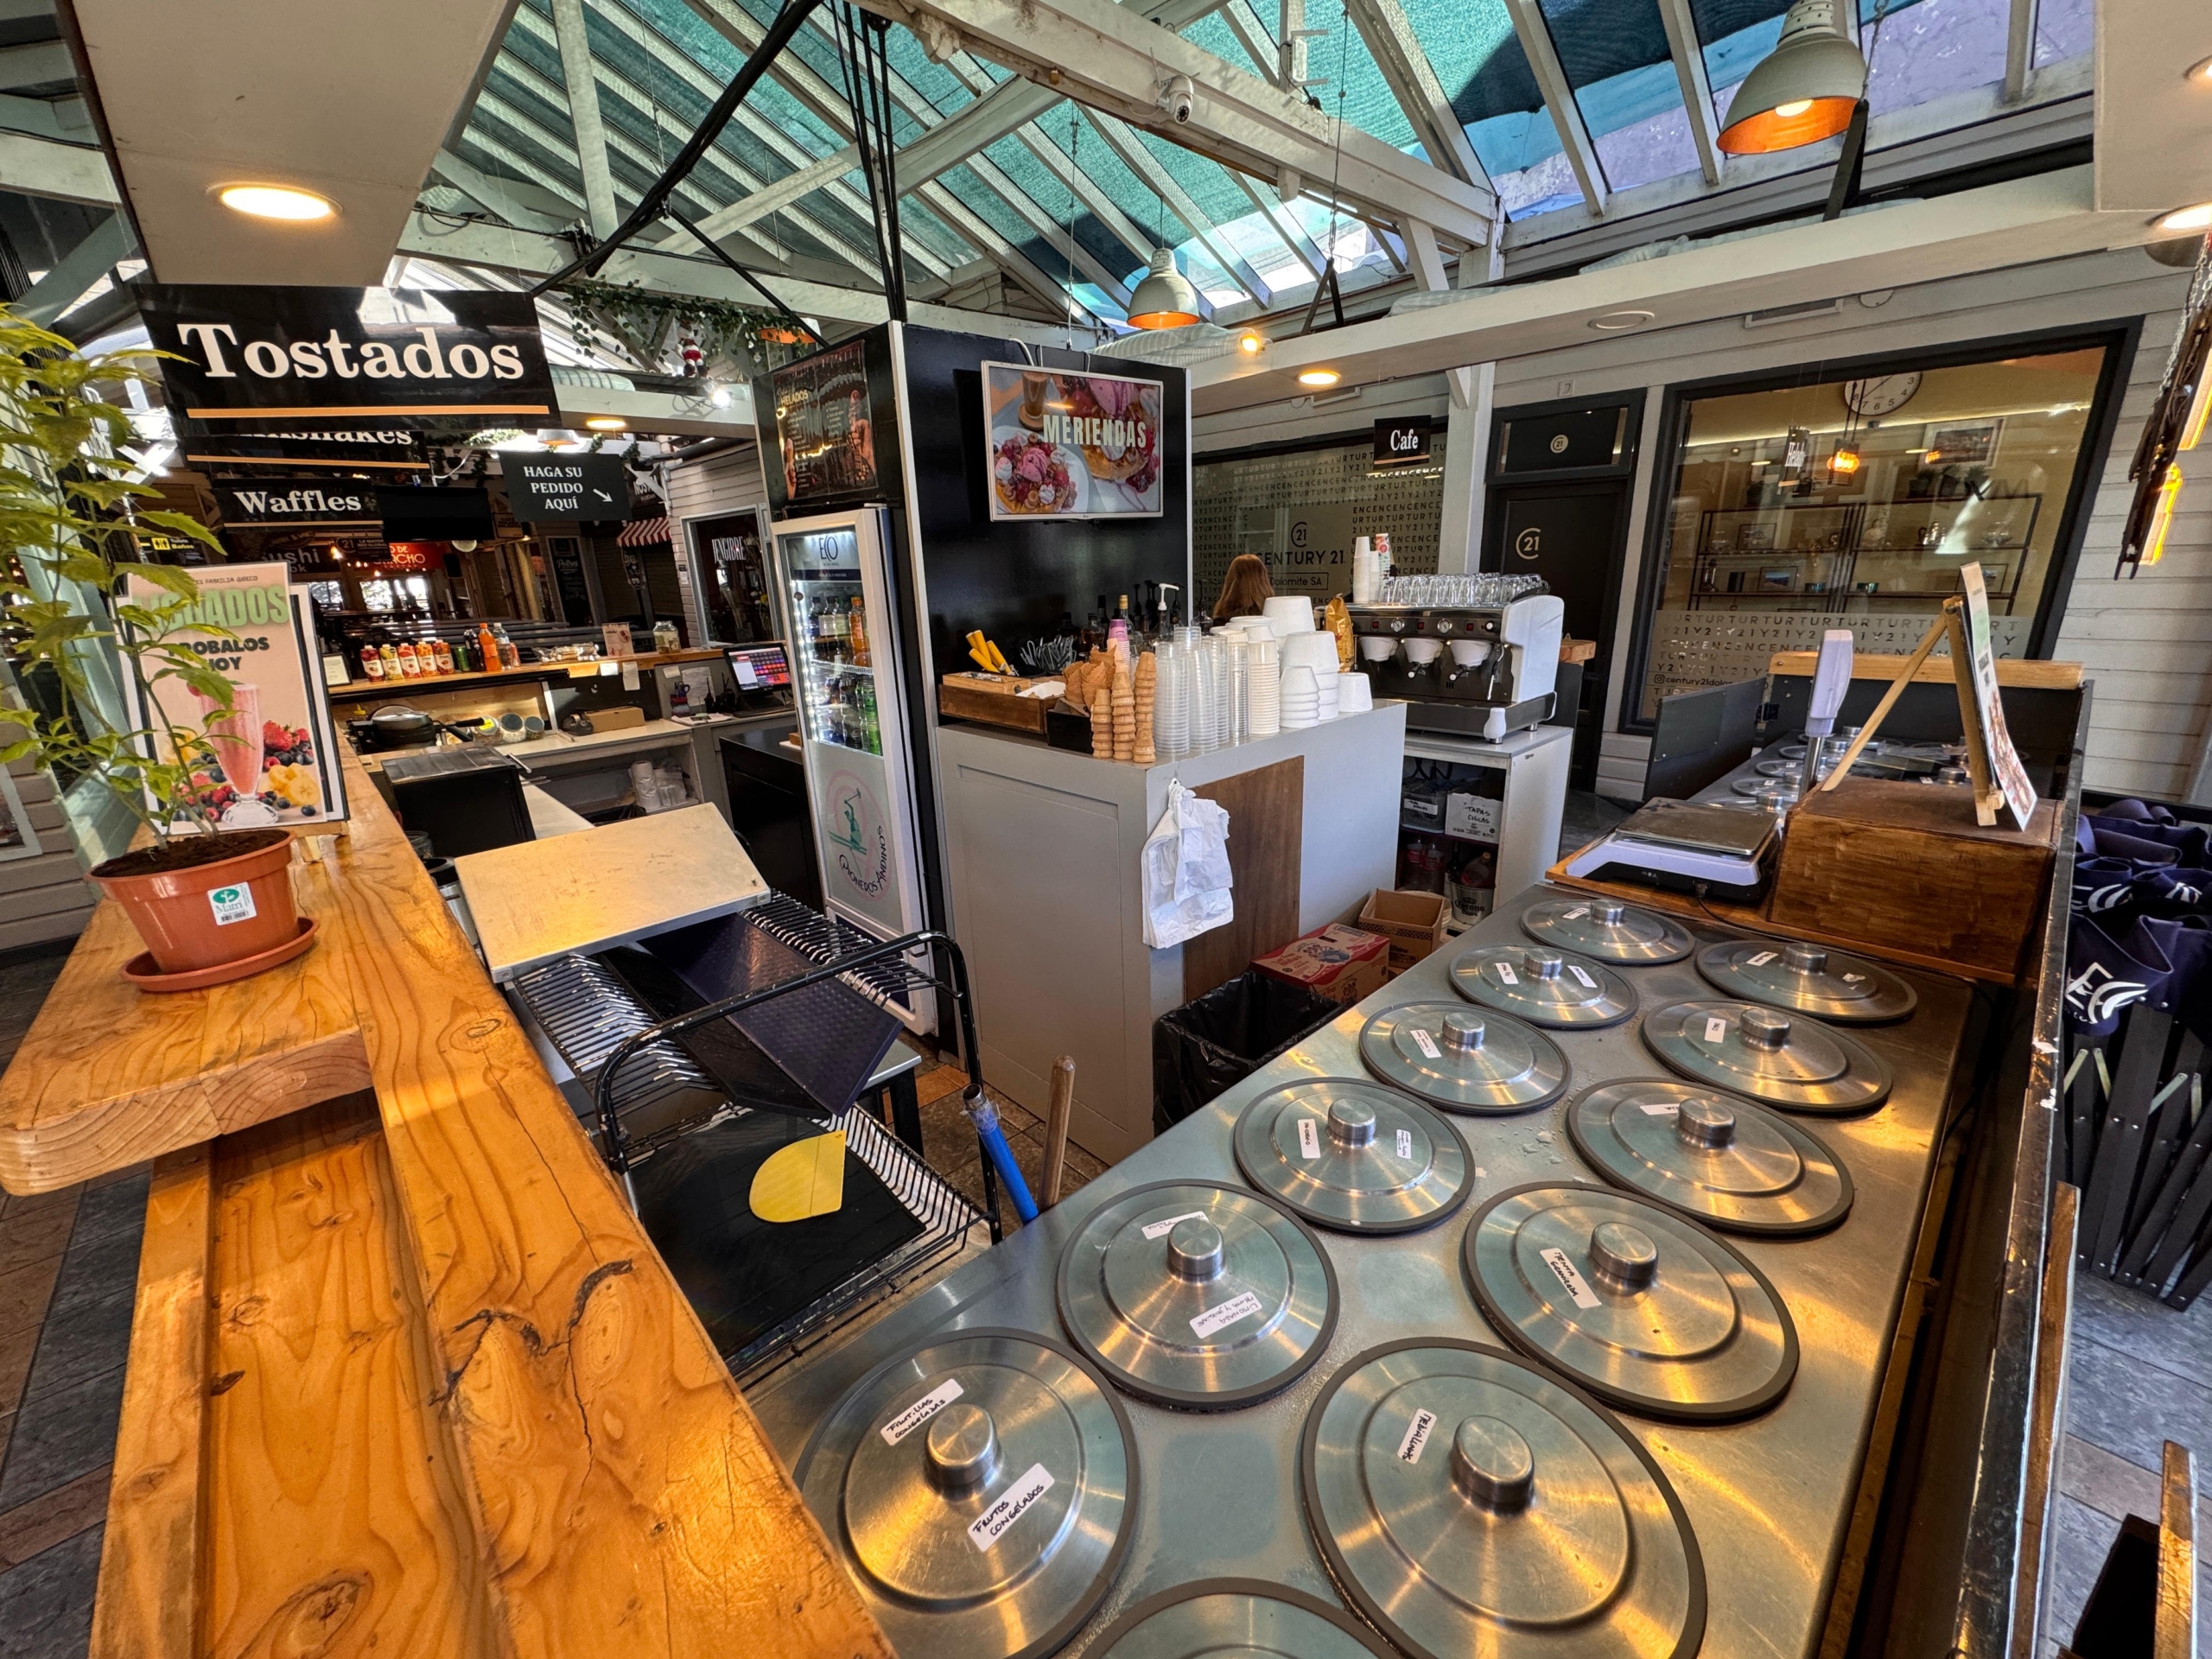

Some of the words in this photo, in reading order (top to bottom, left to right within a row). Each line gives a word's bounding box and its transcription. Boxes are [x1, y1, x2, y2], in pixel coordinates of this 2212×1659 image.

[177, 323, 524, 379] Tostados
[780, 389, 809, 406] HELADOS
[1043, 414, 1147, 448] MERIENDAS
[1390, 429, 1419, 451] Cafe
[523, 467, 563, 478] HAGA
[565, 467, 583, 478] SU
[530, 482, 583, 493] PEDIDO
[232, 490, 362, 515] Waffles
[544, 496, 579, 511] AQUÍ
[1331, 550, 1344, 564] 21
[1311, 576, 1322, 586] SA
[1465, 806, 1491, 817] TAPAS
[1554, 1251, 1575, 1277] MENTA
[1219, 1302, 1258, 1324] LIMONADA
[973, 1500, 1010, 1534] FRUTOS
[989, 1484, 1045, 1536] CONGELADOS
